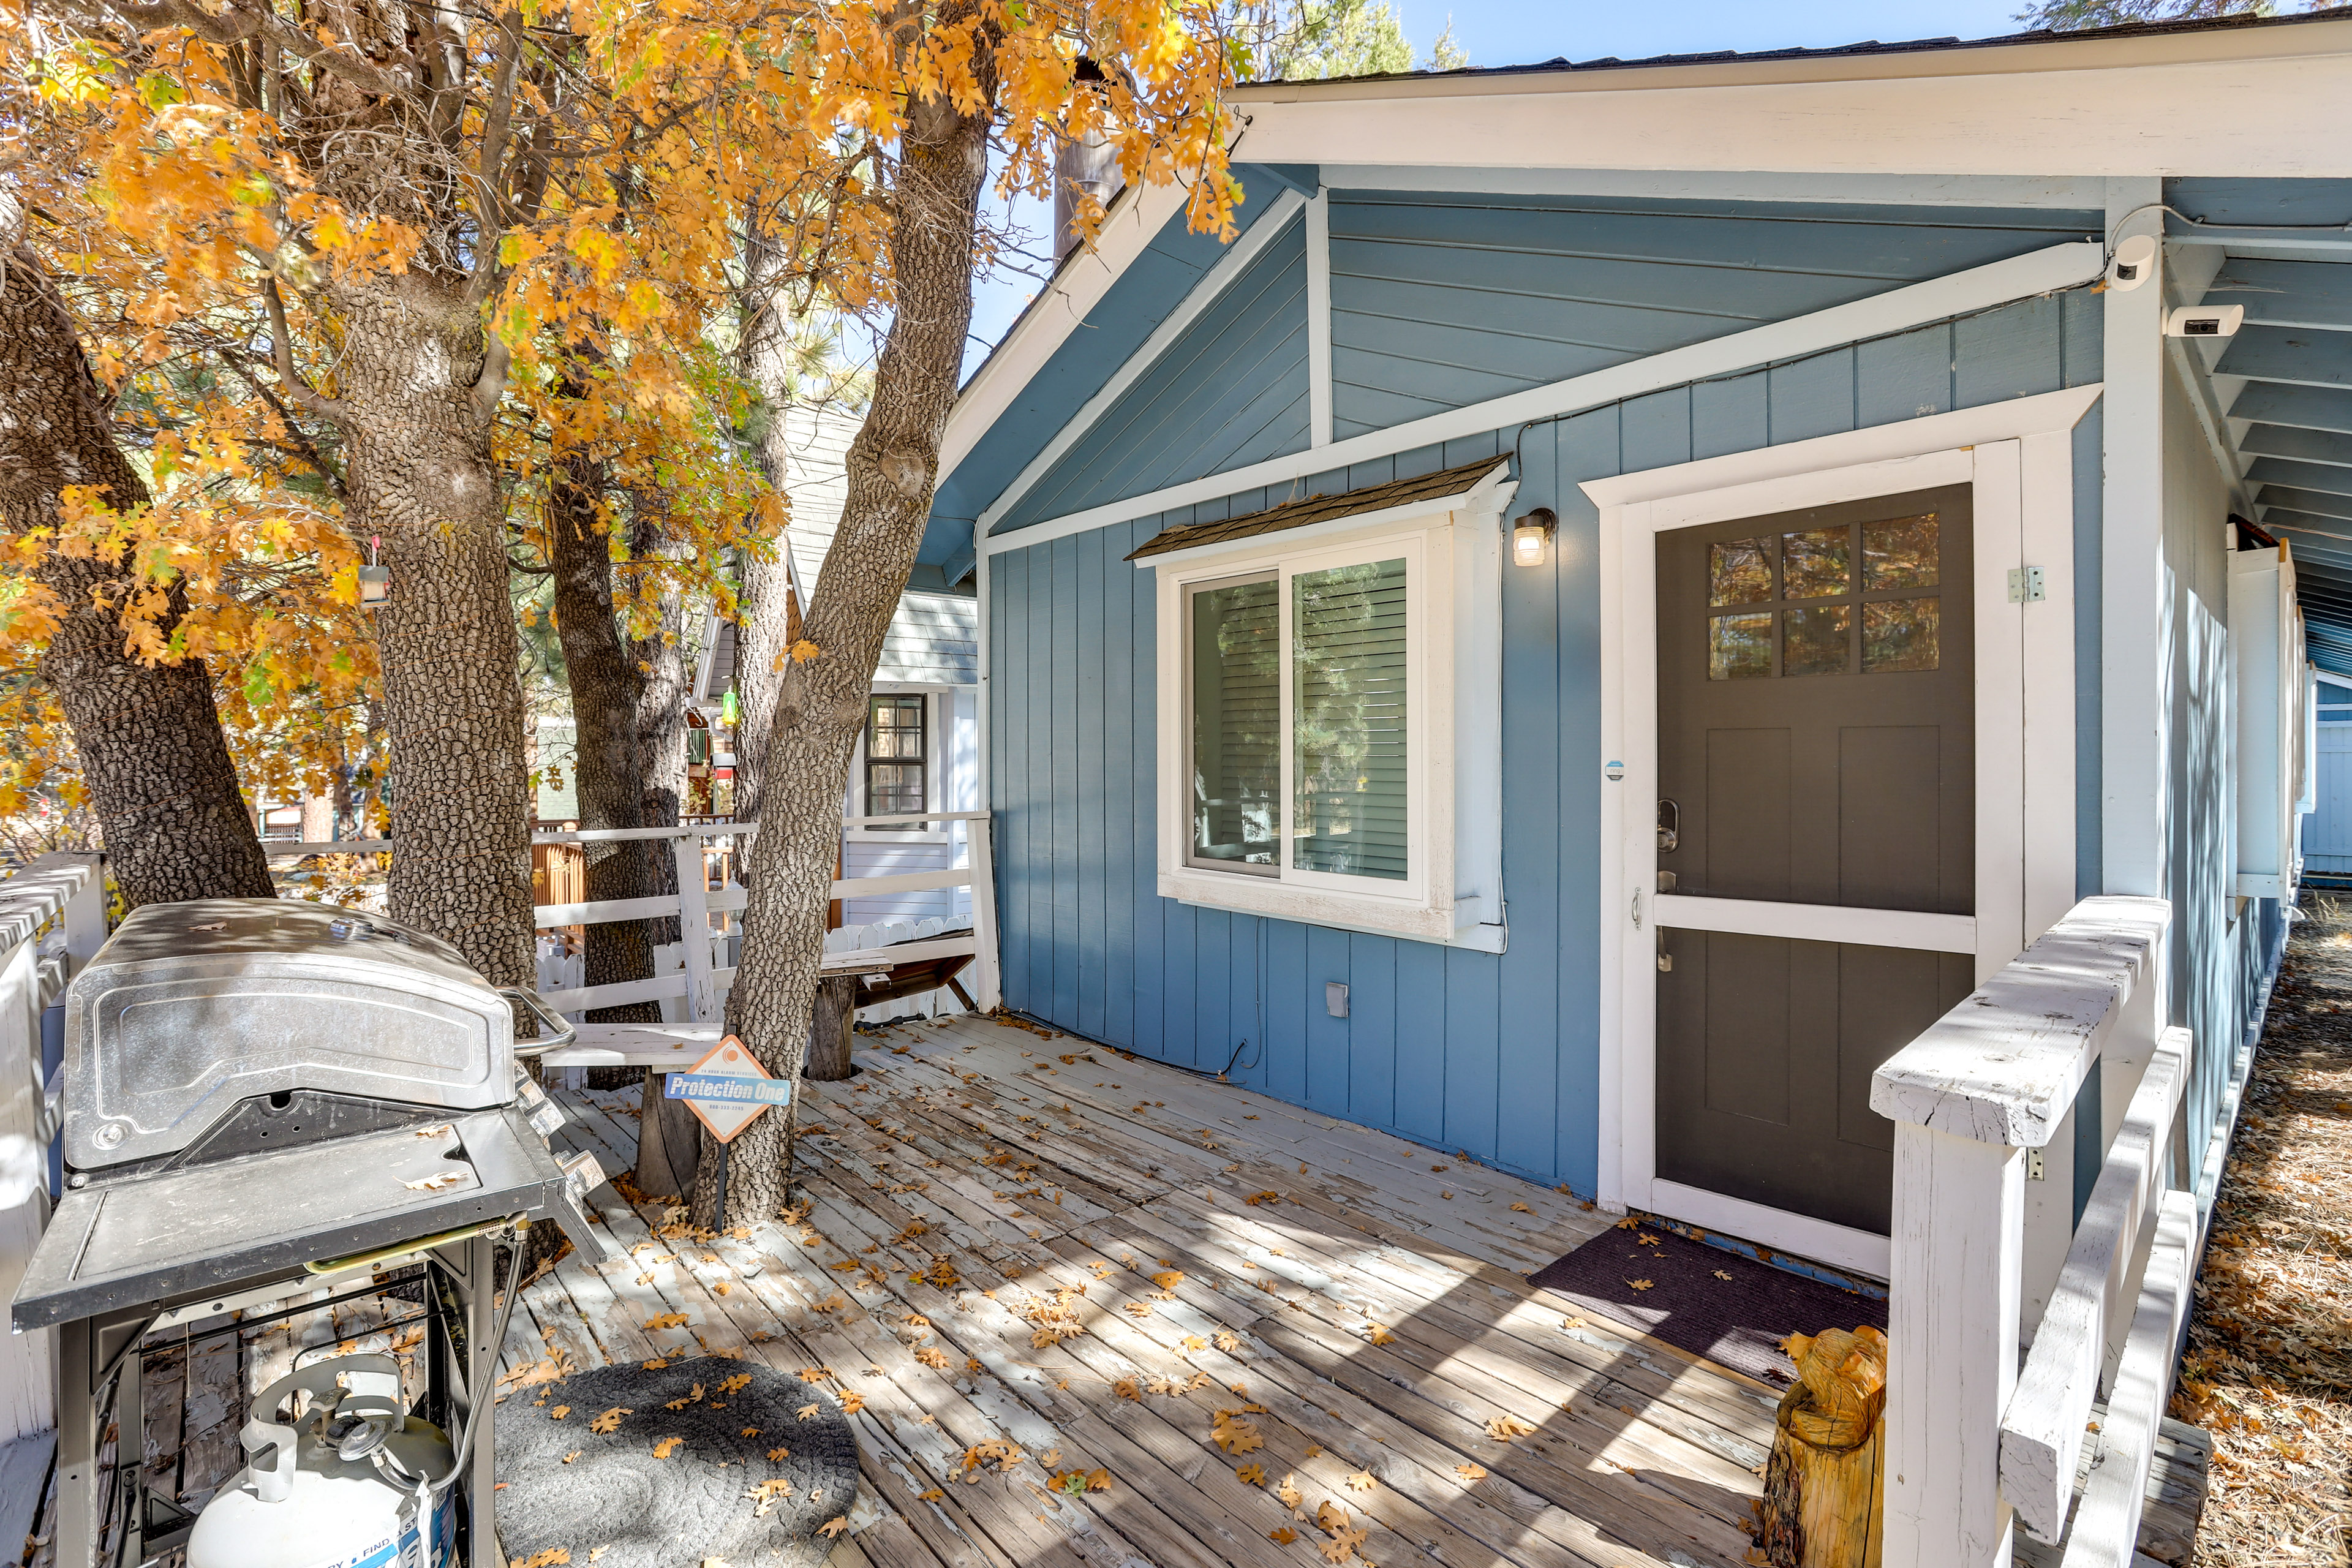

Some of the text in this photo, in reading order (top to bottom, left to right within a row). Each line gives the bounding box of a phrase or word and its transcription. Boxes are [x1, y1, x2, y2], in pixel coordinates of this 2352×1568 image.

[669, 1077, 785, 1102] Protection One
[363, 1538, 390, 1557] FIND
